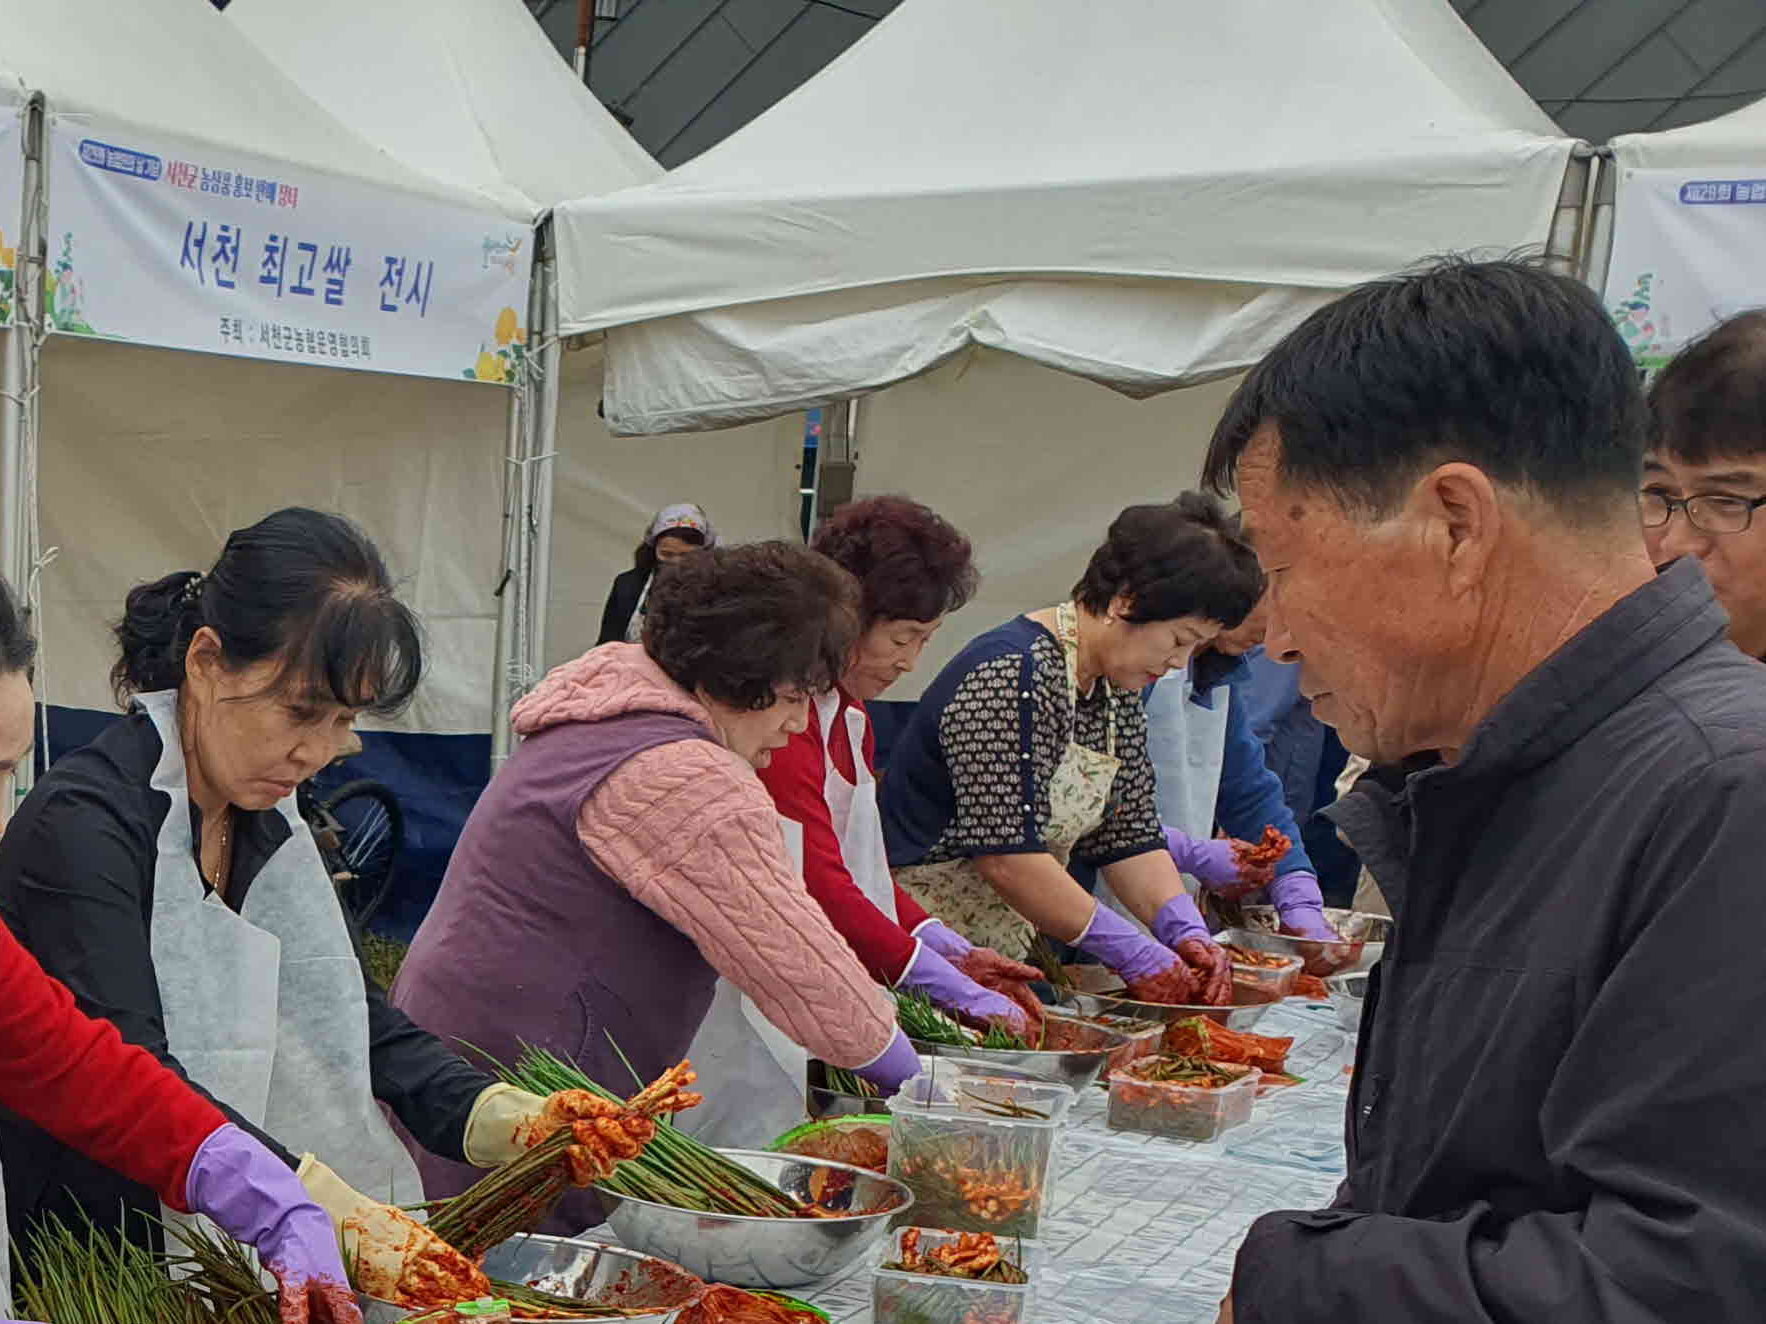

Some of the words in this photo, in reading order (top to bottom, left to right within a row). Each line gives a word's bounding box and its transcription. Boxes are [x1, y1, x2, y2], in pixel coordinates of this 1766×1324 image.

[180, 221, 241, 290] 서천
[258, 234, 352, 307] 최고쌀
[379, 255, 434, 318] 전시
